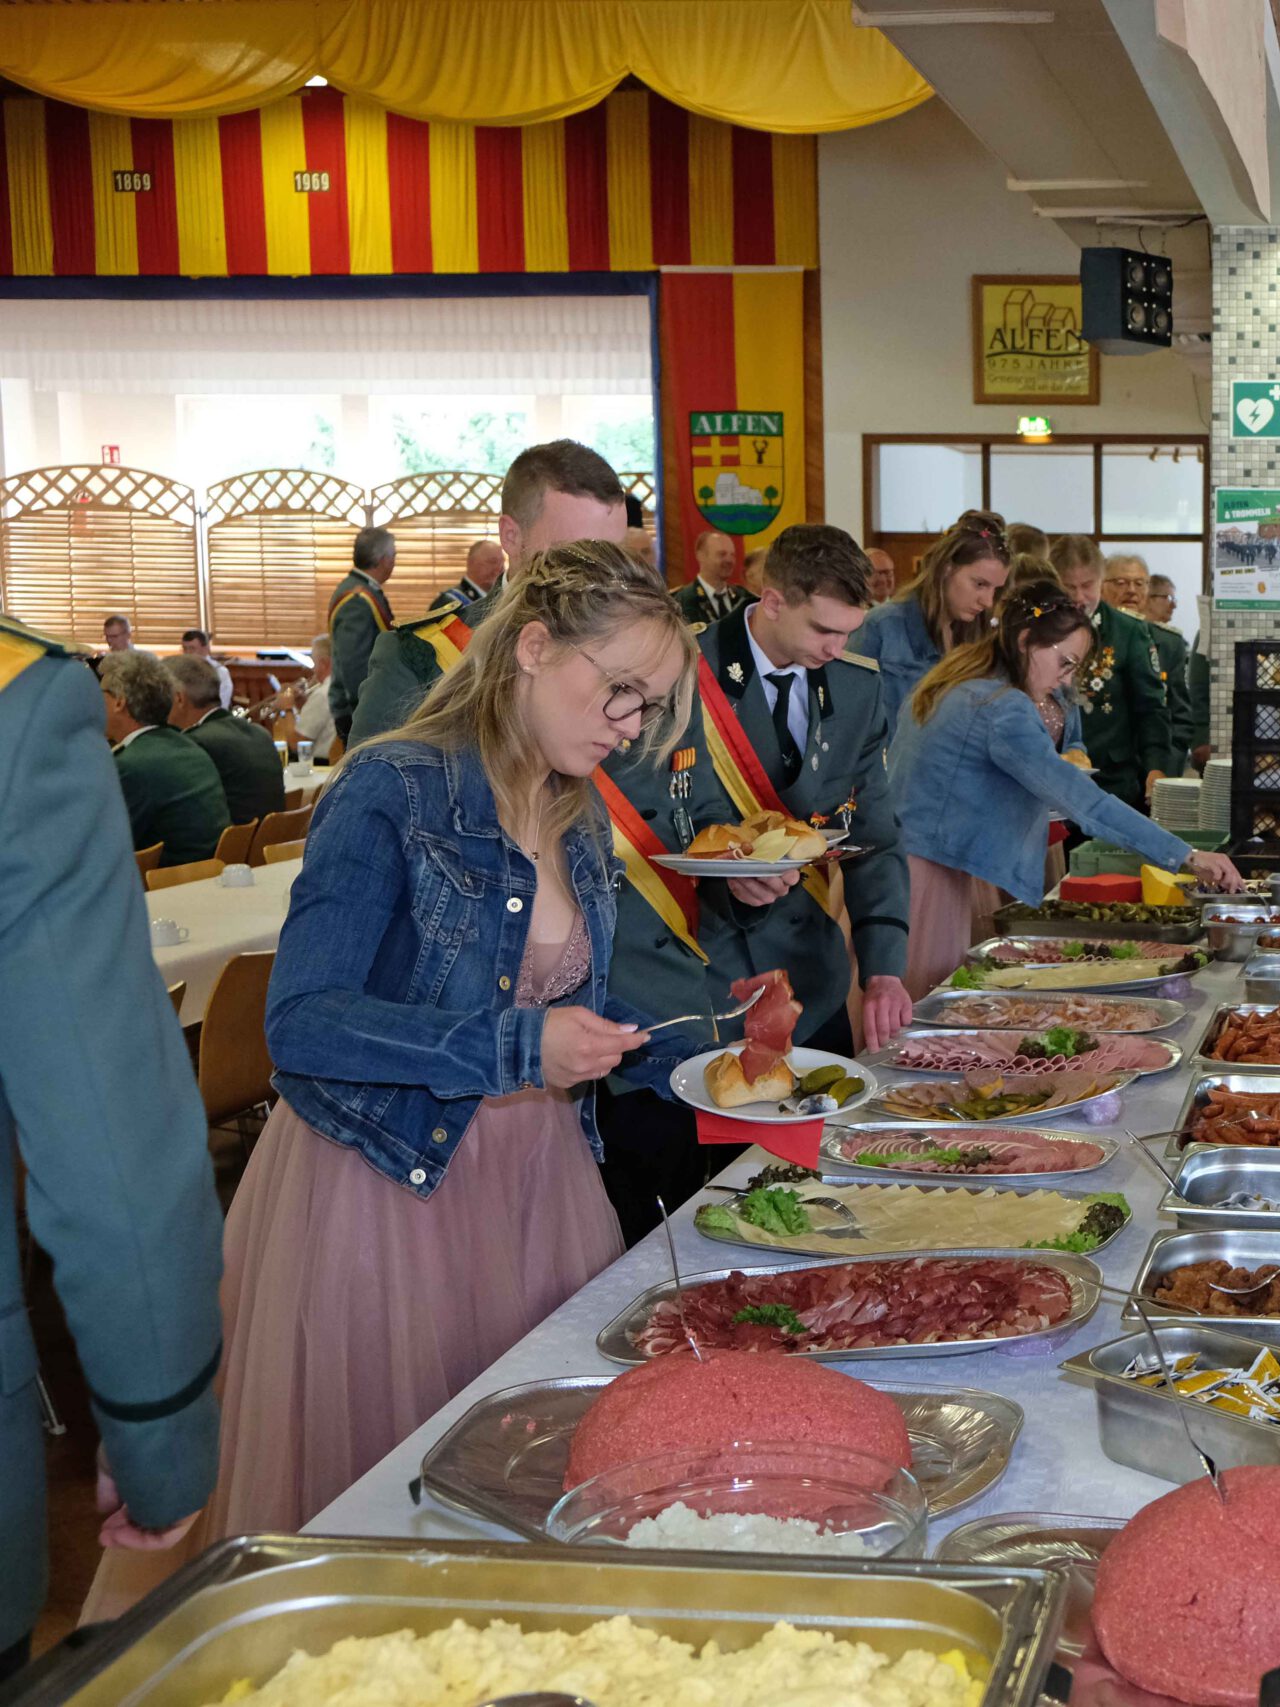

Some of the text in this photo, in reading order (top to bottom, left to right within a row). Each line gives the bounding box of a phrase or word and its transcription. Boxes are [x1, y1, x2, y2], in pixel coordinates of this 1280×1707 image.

[115, 173, 151, 191] 1869
[294, 172, 330, 192] 1969
[989, 328, 1083, 351] ALFEN
[694, 414, 779, 433] ALFEN
